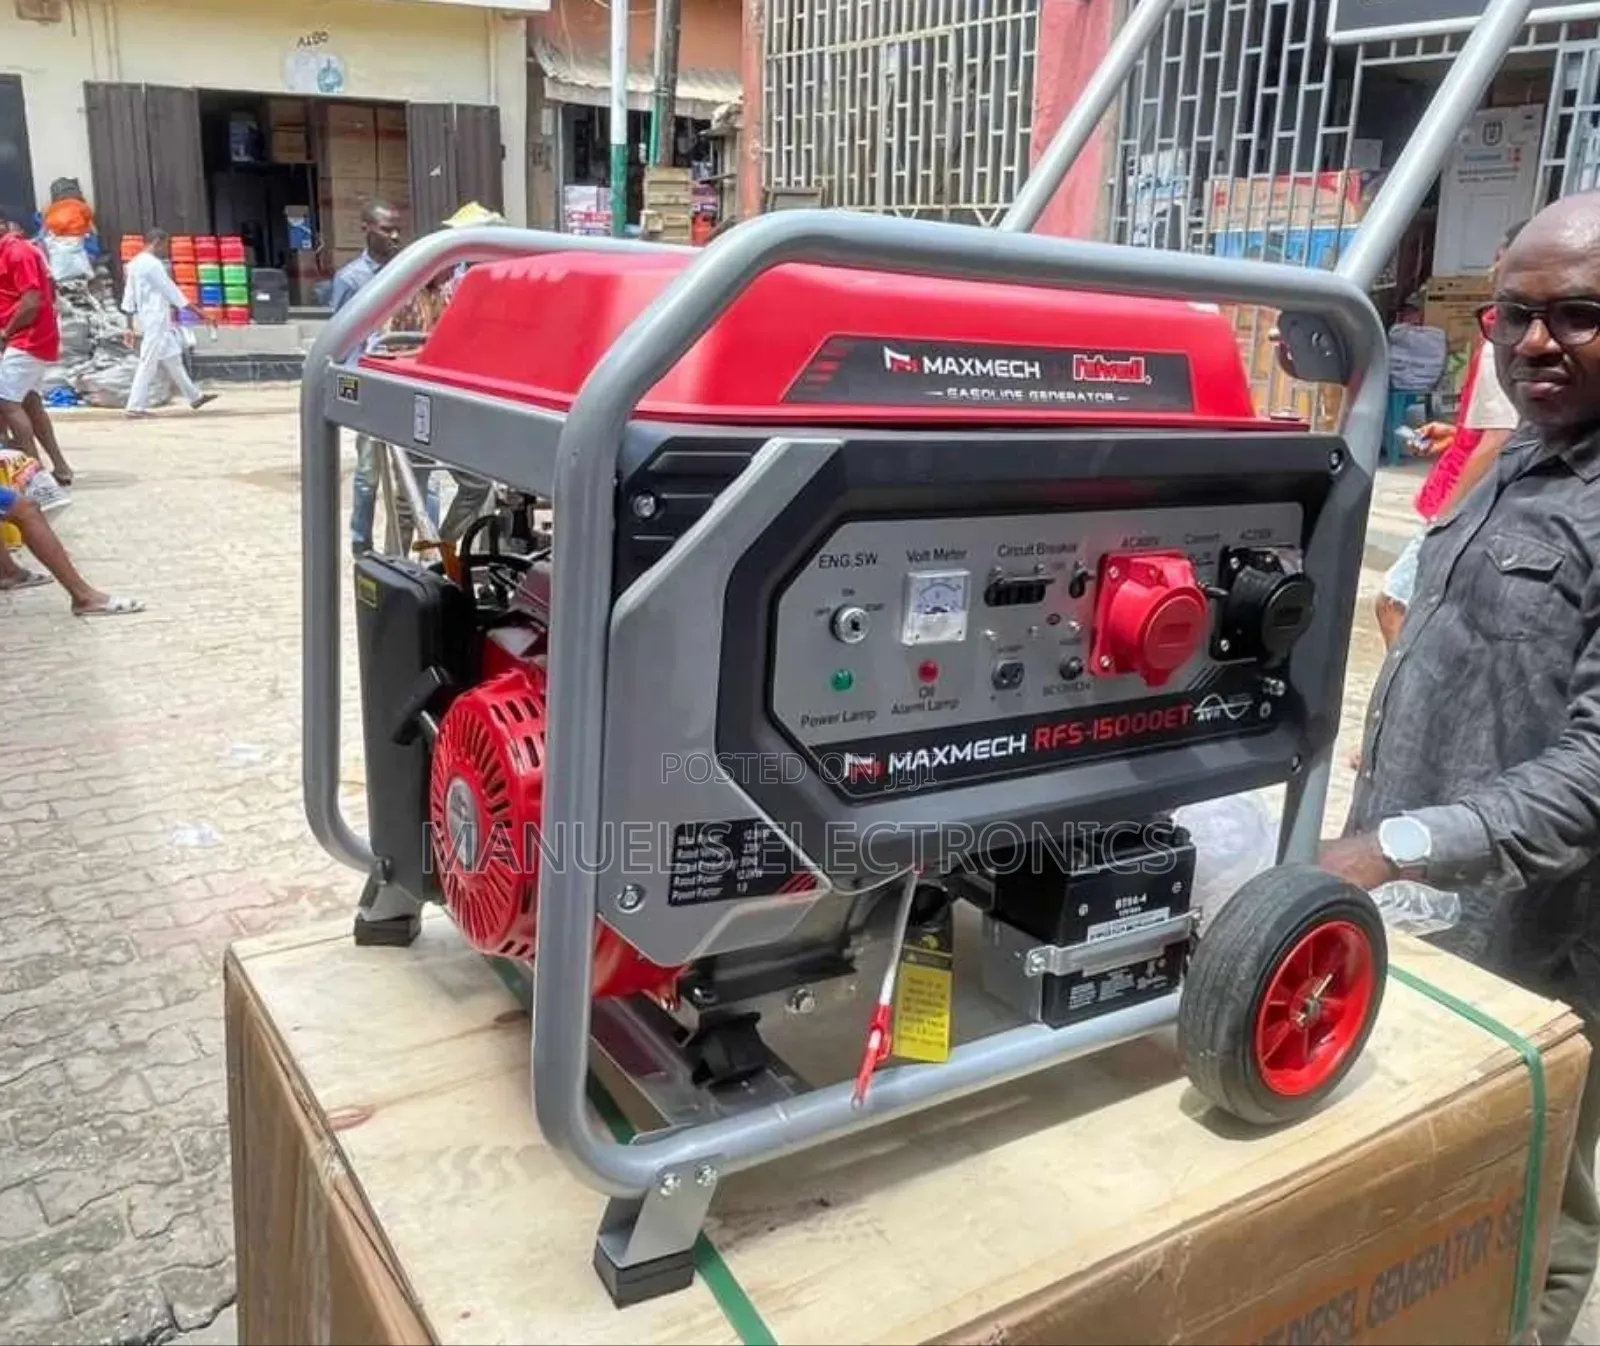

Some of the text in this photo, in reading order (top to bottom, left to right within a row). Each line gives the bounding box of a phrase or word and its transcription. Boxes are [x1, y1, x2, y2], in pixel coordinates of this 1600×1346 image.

[924, 355, 1041, 379] MAXMECH
[1029, 389, 1114, 403] GENERATOR
[906, 548, 968, 563] Volt Meter
[998, 541, 1077, 557] Circuit Breaker
[890, 698, 960, 715] Alarm Lamp
[800, 709, 877, 728] Power Lamp
[888, 704, 1193, 774] MAXMECH RFS-15000ET
[1366, 1215, 1494, 1329] GENERATOR
